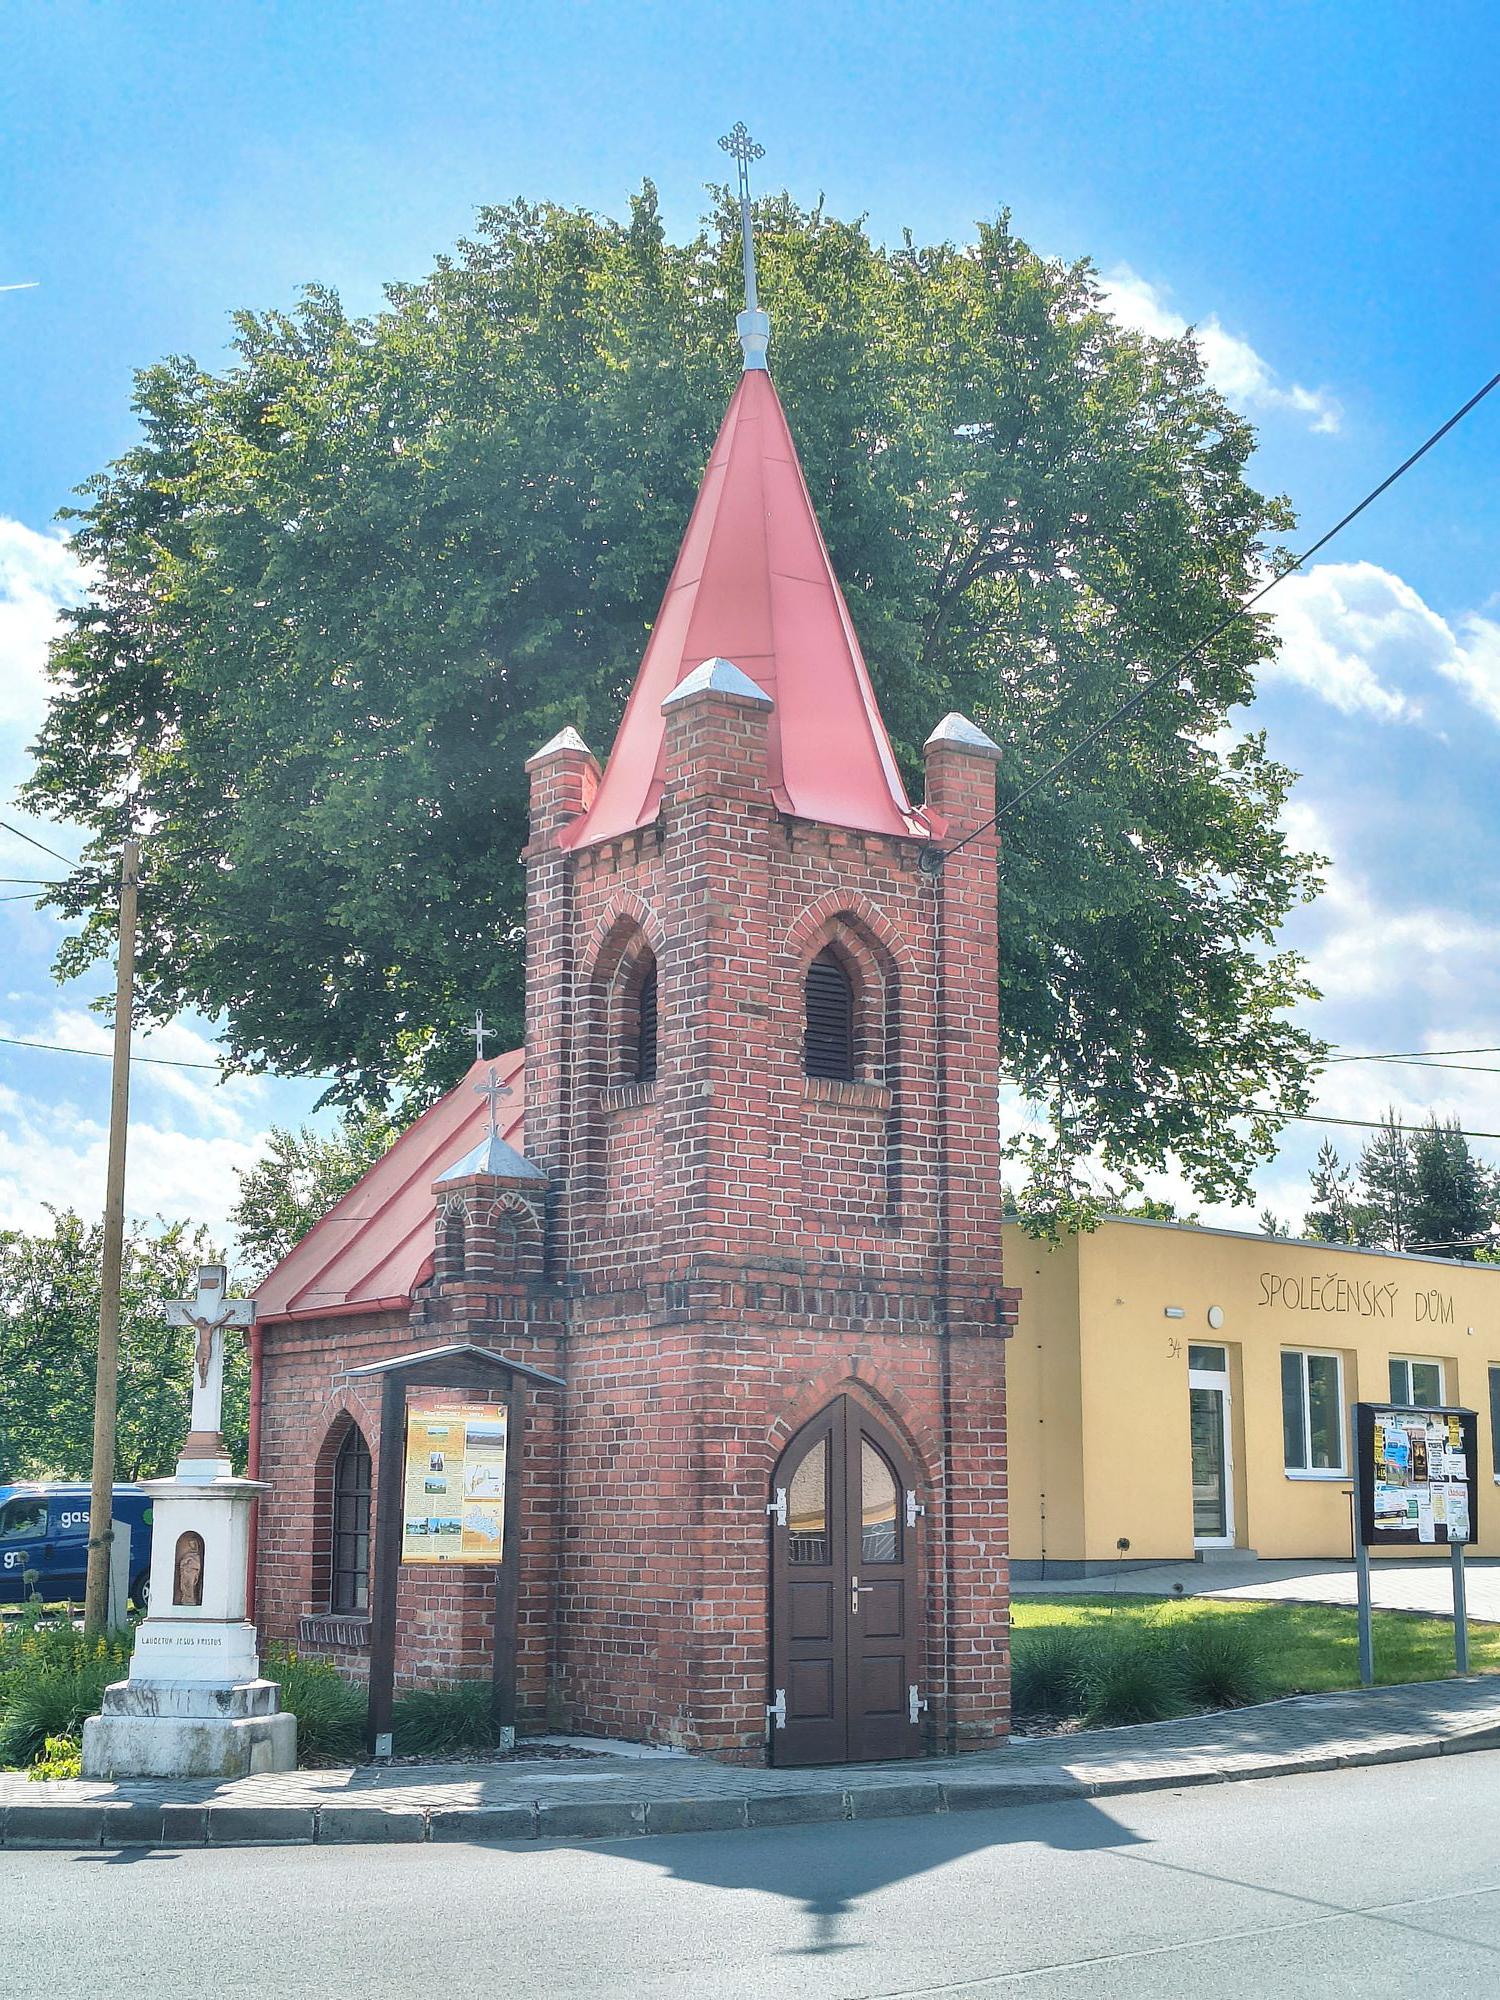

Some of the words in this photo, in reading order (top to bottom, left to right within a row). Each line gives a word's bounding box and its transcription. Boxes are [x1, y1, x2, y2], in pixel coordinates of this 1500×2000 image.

[1258, 1272, 1398, 1318] SPOLEČENSKÝ
[1415, 1289, 1454, 1325] DŮM
[1165, 1337, 1183, 1359] 34
